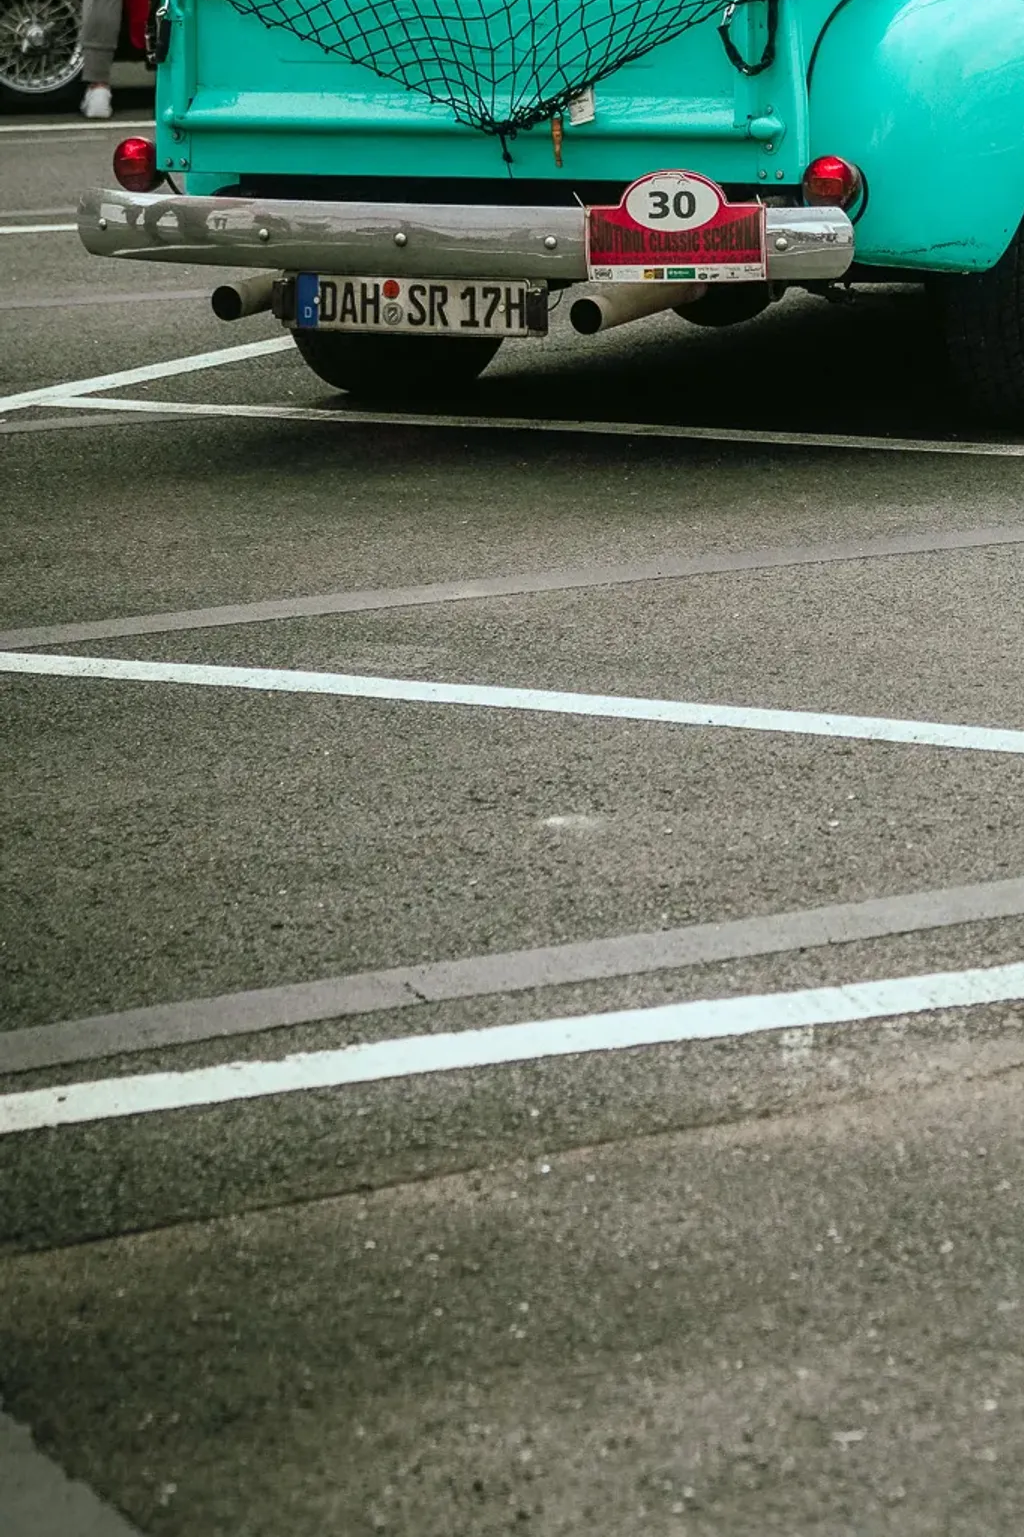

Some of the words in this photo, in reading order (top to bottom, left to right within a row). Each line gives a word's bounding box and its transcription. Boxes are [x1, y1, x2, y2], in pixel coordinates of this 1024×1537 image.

[648, 190, 697, 220] 30
[650, 231, 699, 253] CLASSIC
[304, 306, 312, 319] D
[319, 280, 380, 325] DAH
[408, 284, 449, 327] SR
[460, 287, 526, 329] 17H
